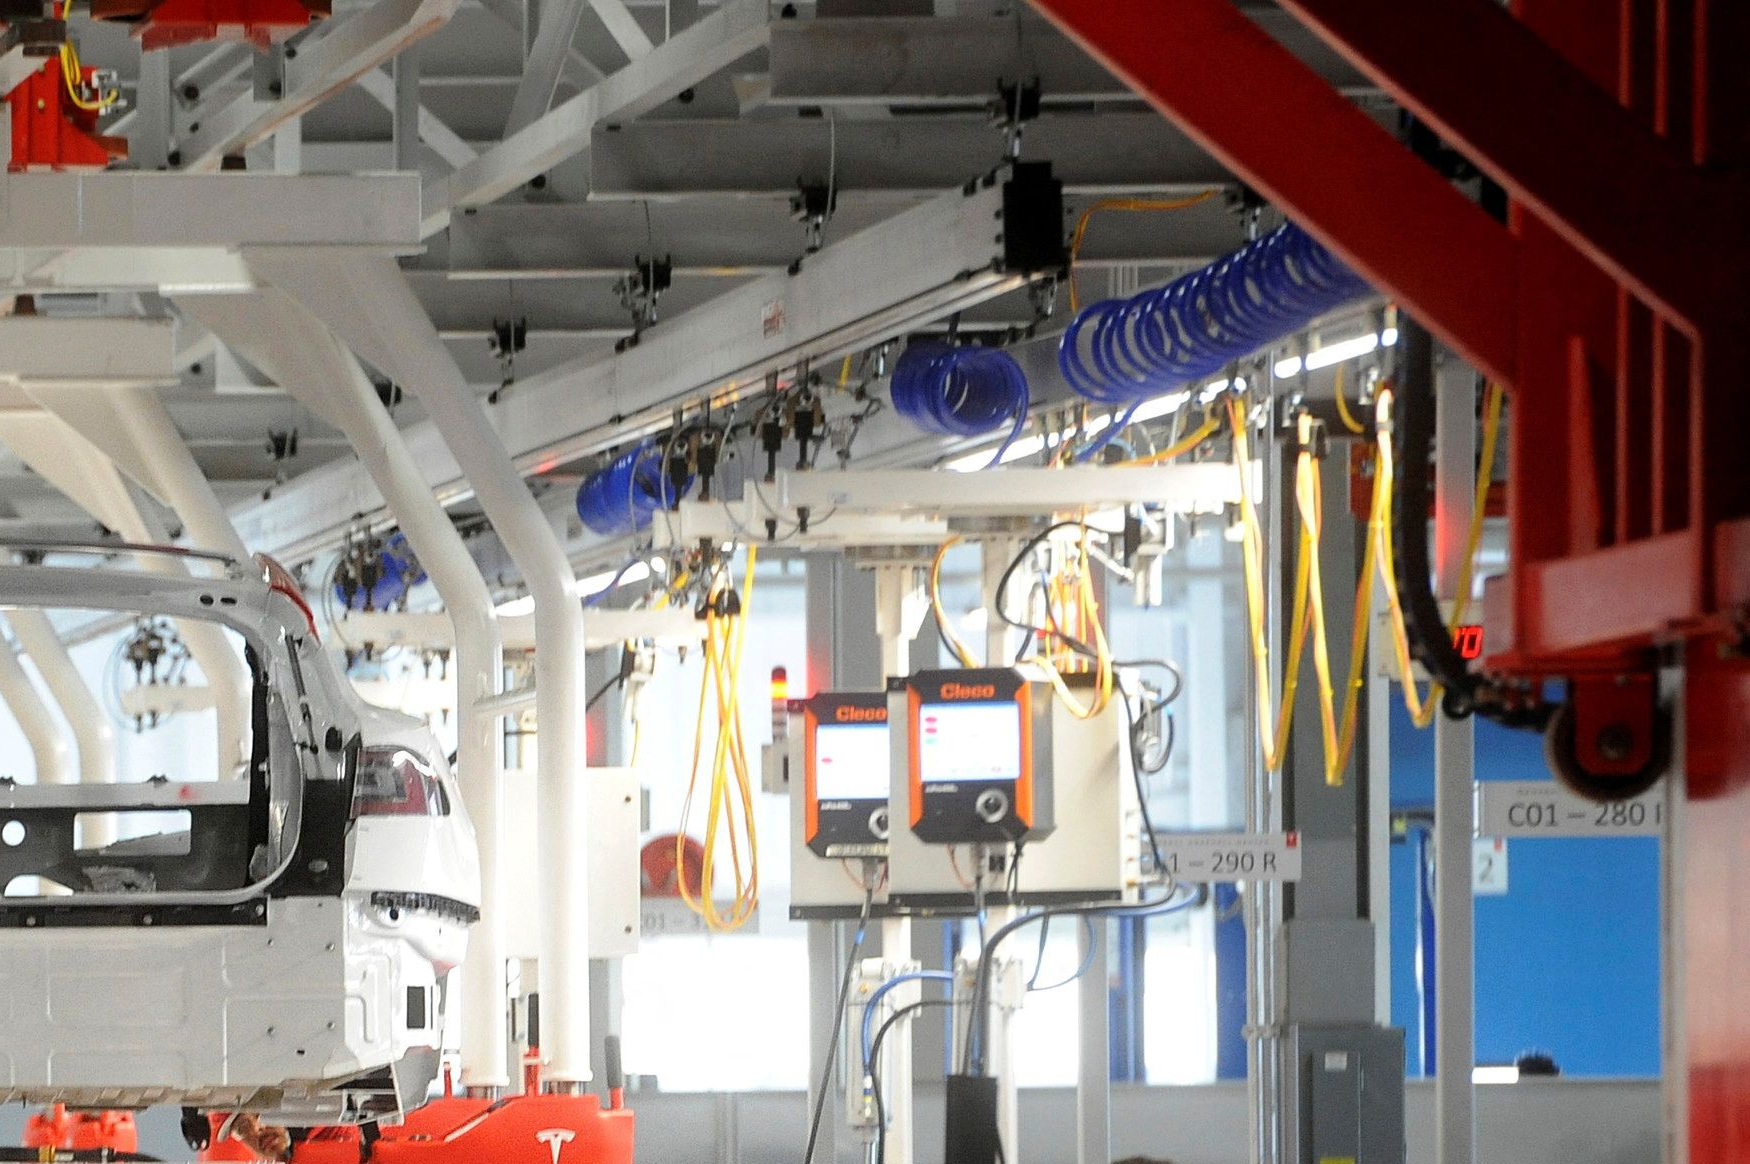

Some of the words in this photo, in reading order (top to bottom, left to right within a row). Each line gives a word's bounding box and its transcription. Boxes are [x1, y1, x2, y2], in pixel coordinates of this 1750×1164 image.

[940, 683, 996, 699] Cleco
[836, 705, 888, 721] Cleco
[1508, 802, 1558, 827] C01
[1594, 802, 1645, 827] 280
[1211, 852, 1254, 873] 290
[1263, 852, 1277, 873] R
